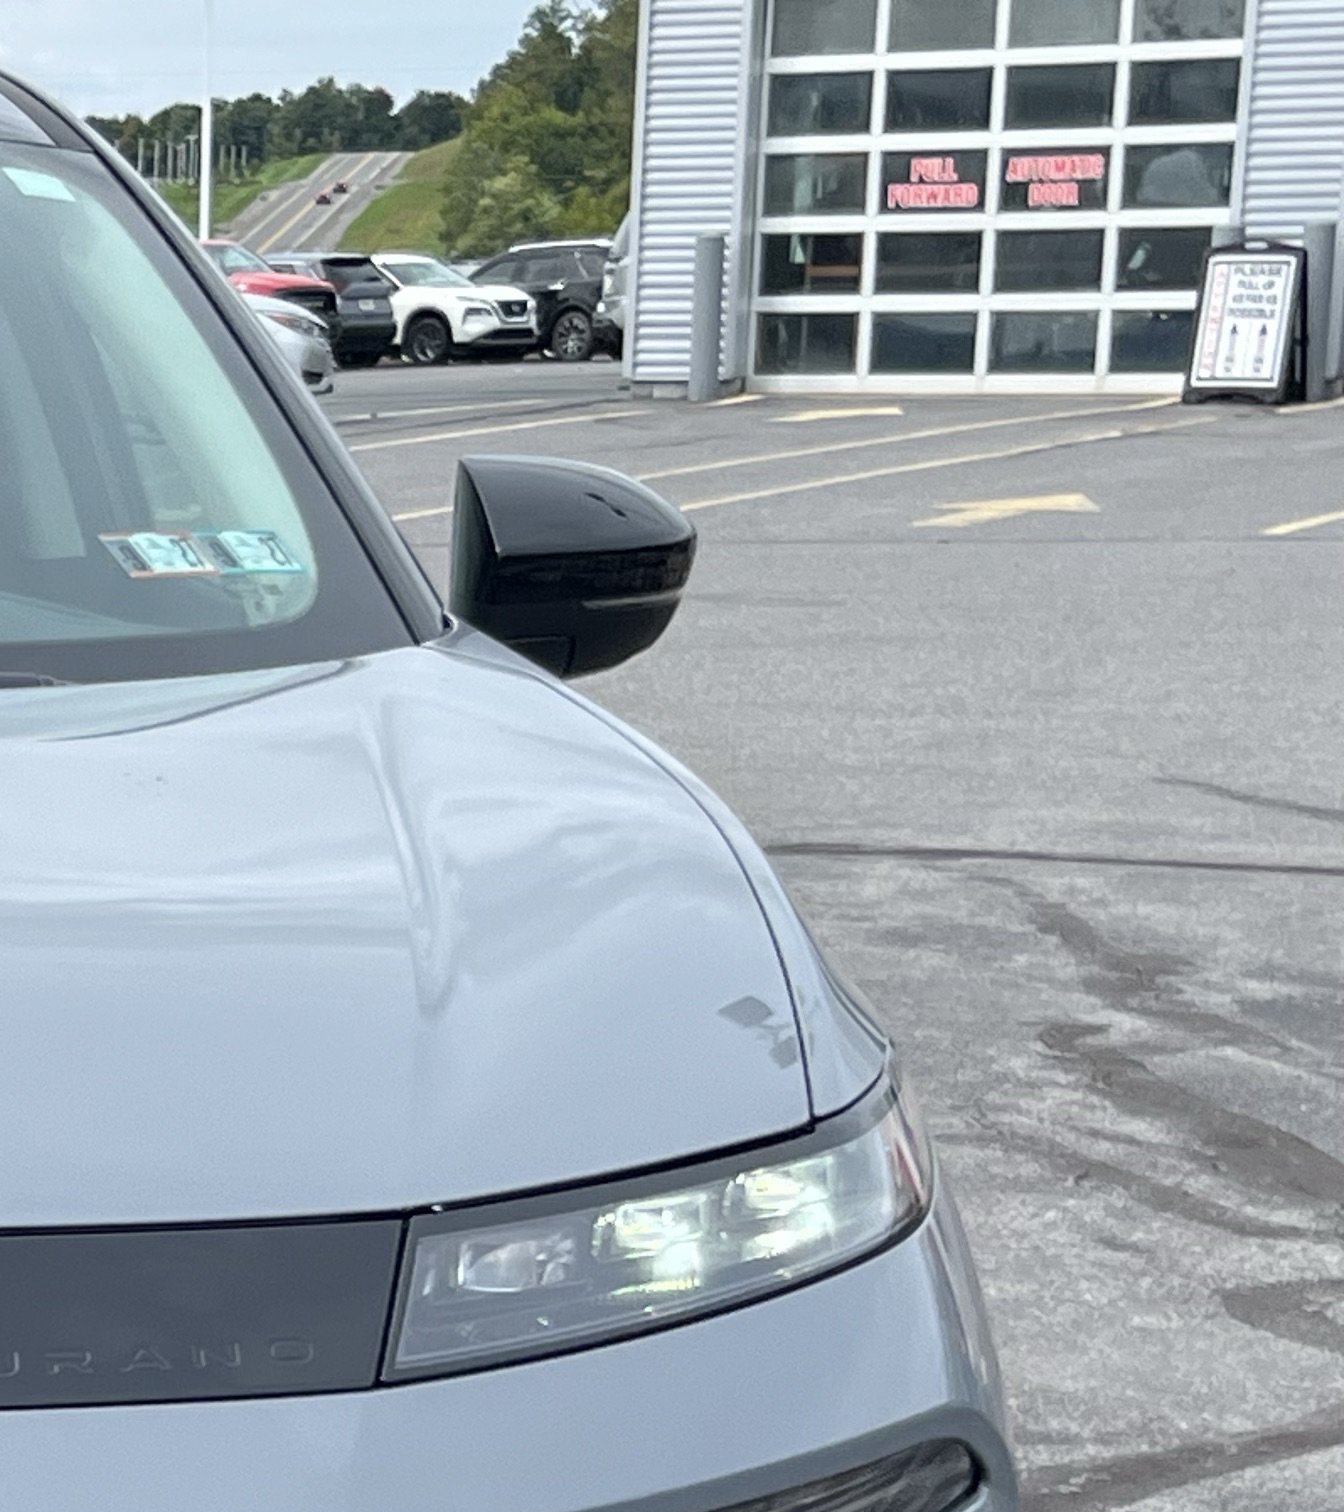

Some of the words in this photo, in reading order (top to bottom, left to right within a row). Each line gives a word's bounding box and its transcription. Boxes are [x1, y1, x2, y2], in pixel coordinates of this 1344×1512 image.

[910, 156, 958, 182] PULL
[1005, 154, 1104, 183] AUTOMATIC
[887, 183, 978, 209] FORWARD
[1028, 181, 1079, 207] DOOR
